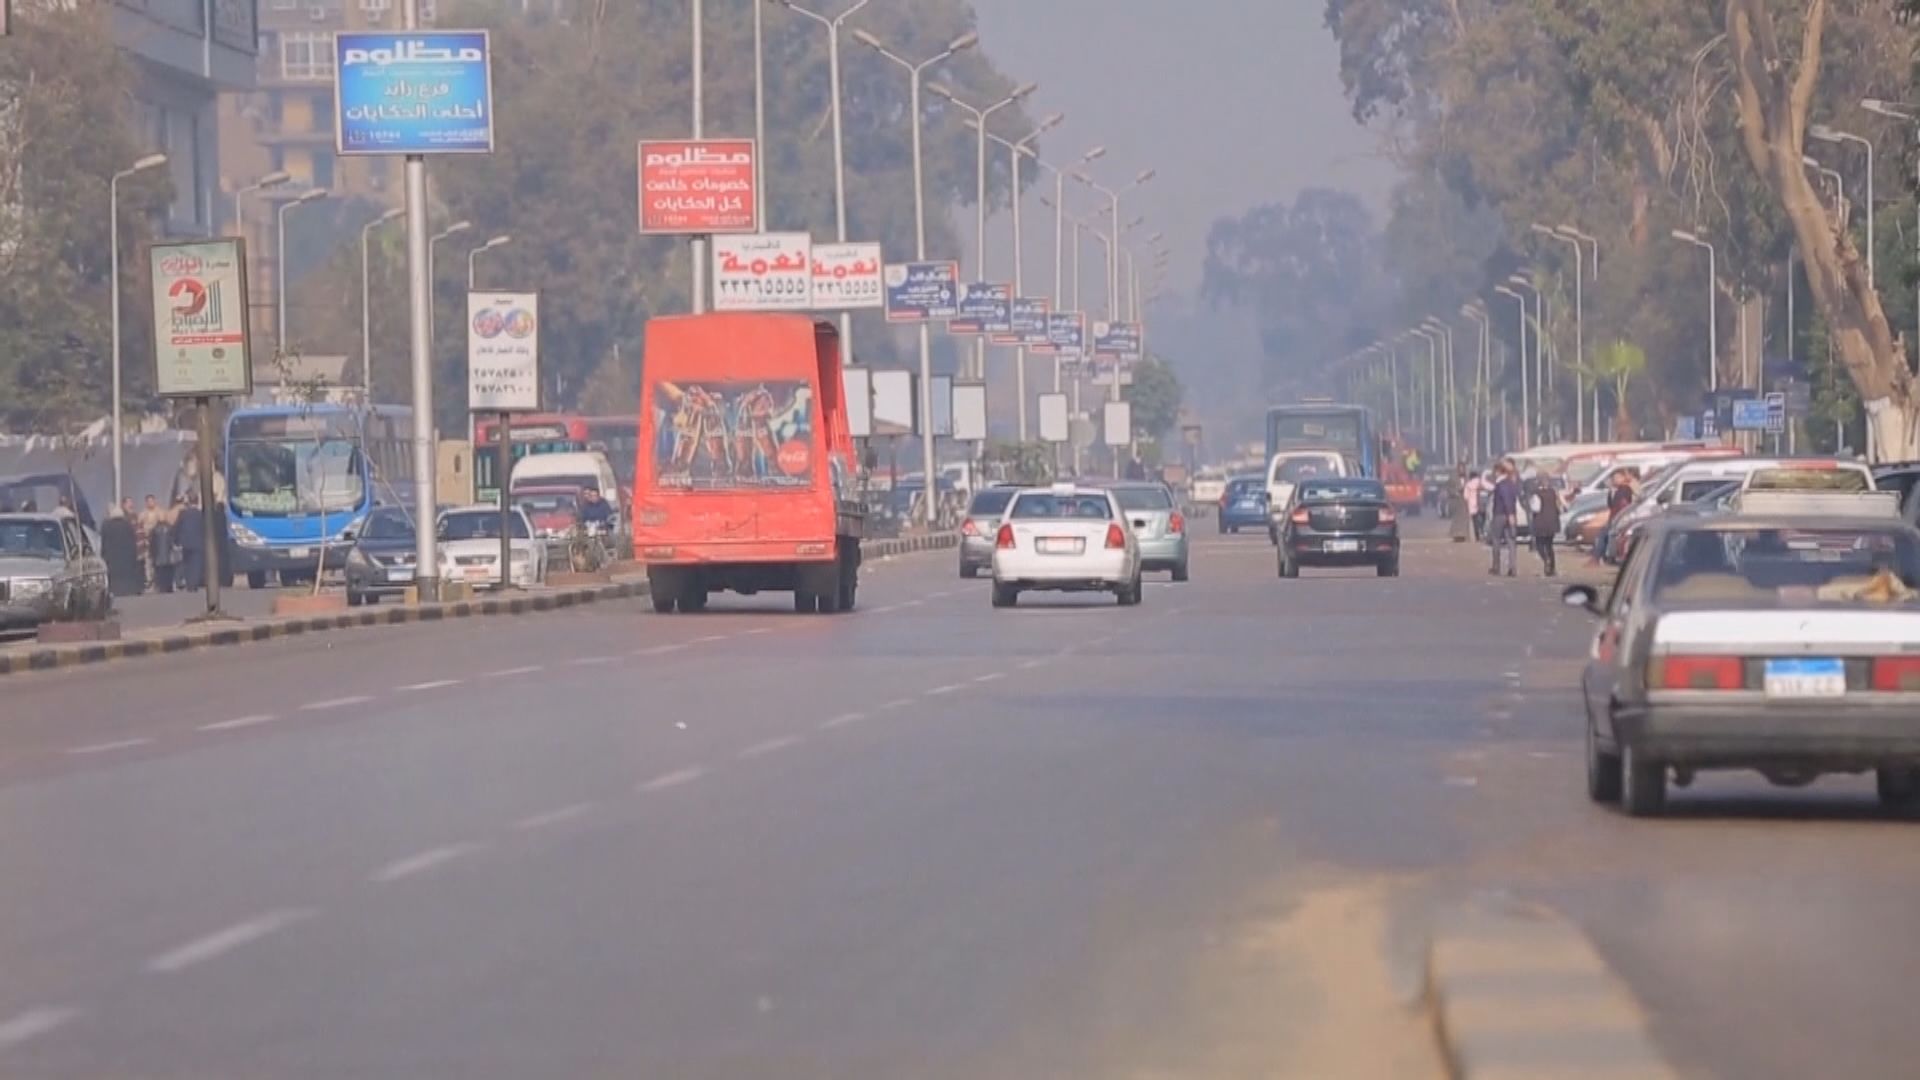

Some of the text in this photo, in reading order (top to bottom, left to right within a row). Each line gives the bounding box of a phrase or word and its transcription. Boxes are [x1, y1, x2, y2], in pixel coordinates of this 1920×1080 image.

[344, 40, 482, 65] مظلوم
[419, 82, 449, 99] فرع
[346, 99, 482, 122] أحلى الحكايات
[646, 147, 750, 167] مظلوم
[653, 196, 743, 212] كل الحكايات
[718, 251, 806, 275] نعمة
